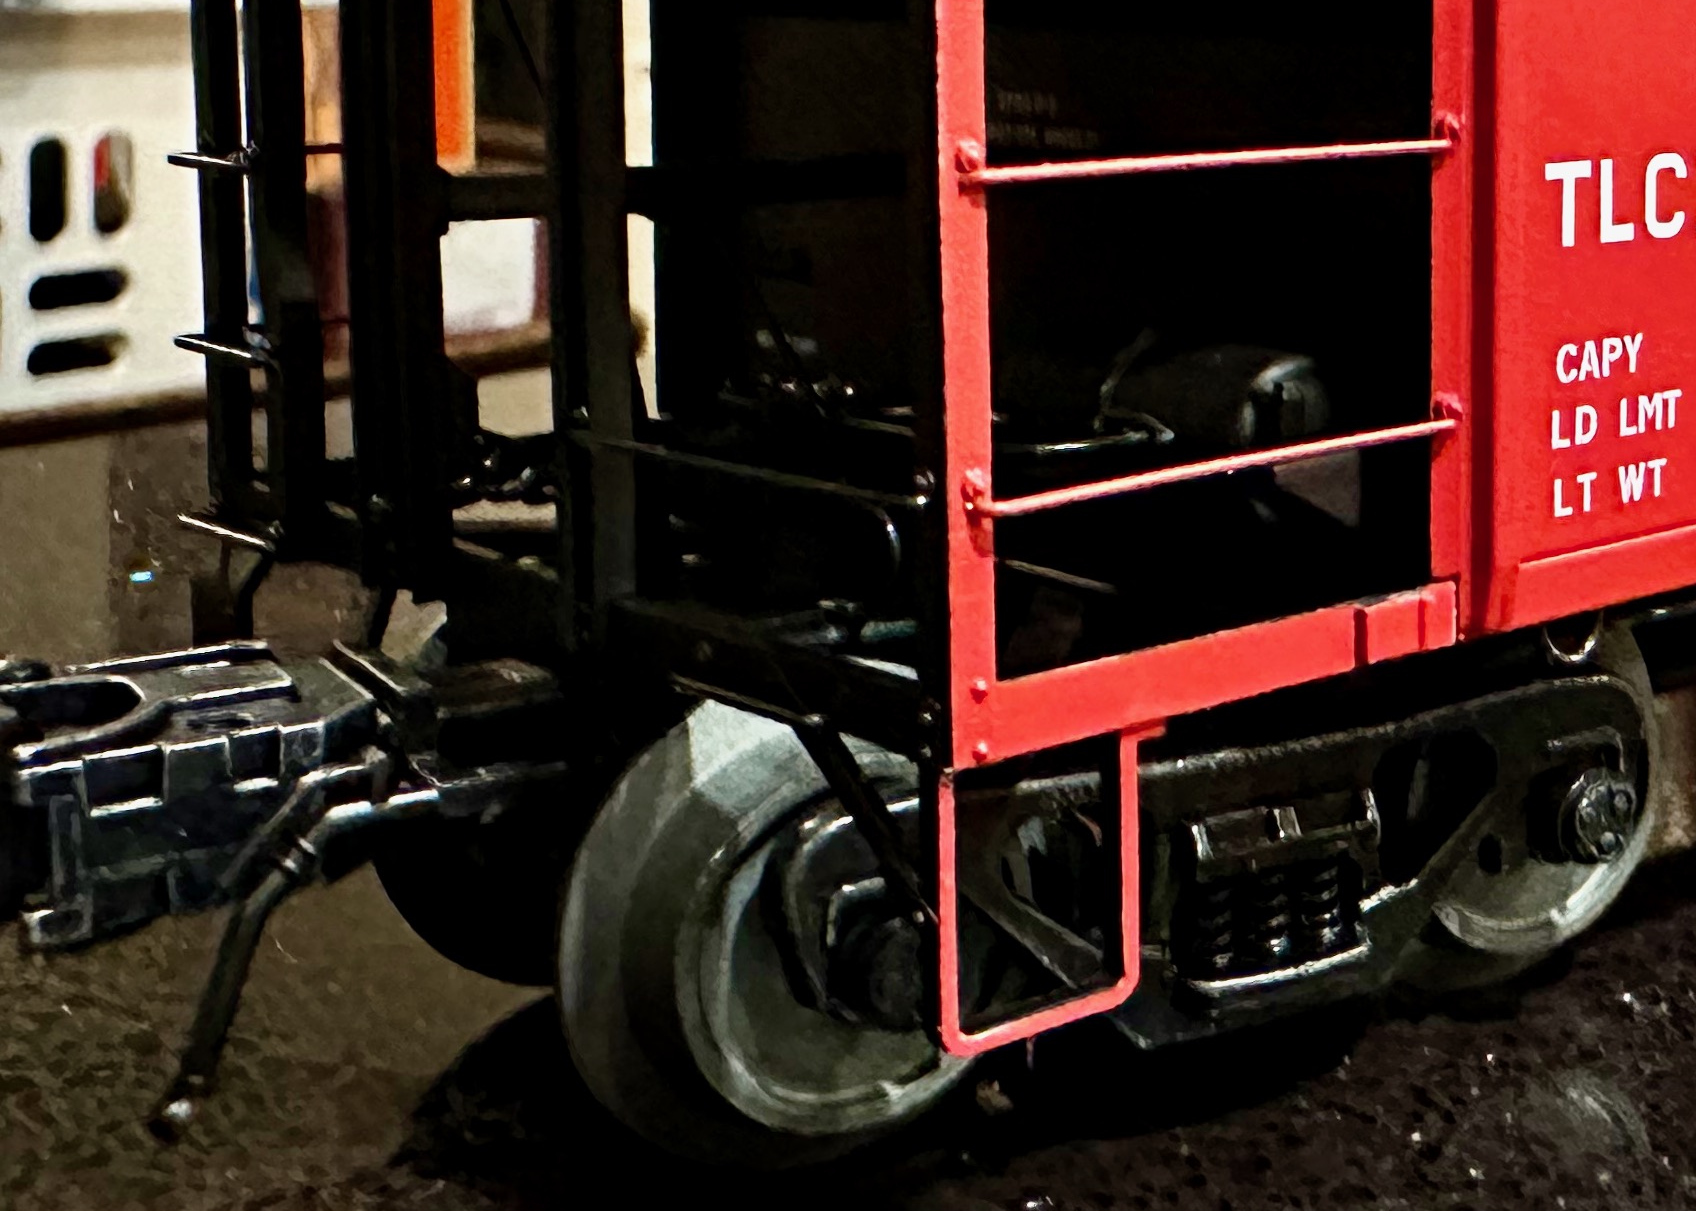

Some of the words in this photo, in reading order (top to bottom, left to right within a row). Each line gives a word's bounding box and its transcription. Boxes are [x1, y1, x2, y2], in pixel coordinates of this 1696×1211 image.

[1556, 332, 1644, 384] CAPY
[1551, 404, 1598, 450] LD
[1619, 388, 1683, 437] LMT
[1553, 471, 1598, 518] LT
[1618, 457, 1668, 504] WT
